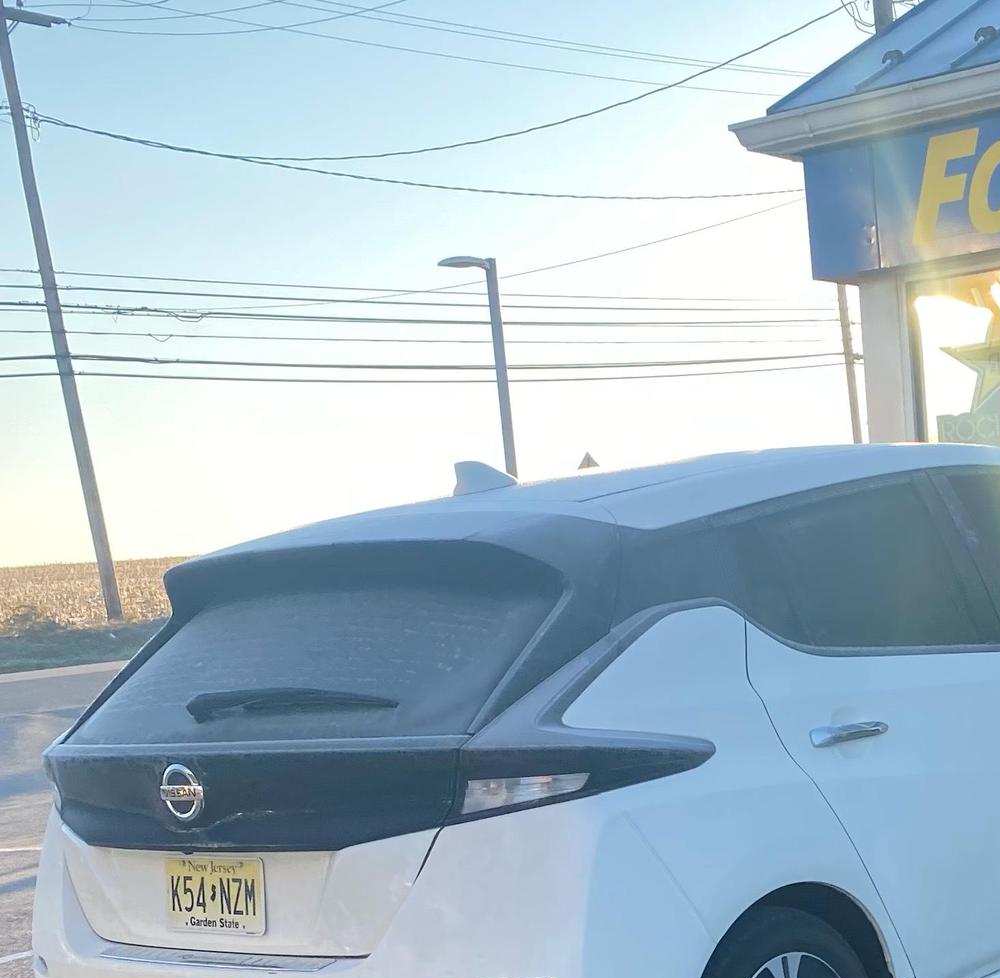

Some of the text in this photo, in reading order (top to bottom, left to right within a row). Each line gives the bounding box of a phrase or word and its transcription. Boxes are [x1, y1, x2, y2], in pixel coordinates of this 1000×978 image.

[188, 860, 237, 875] New Jersey
[190, 916, 240, 929] Garden State
